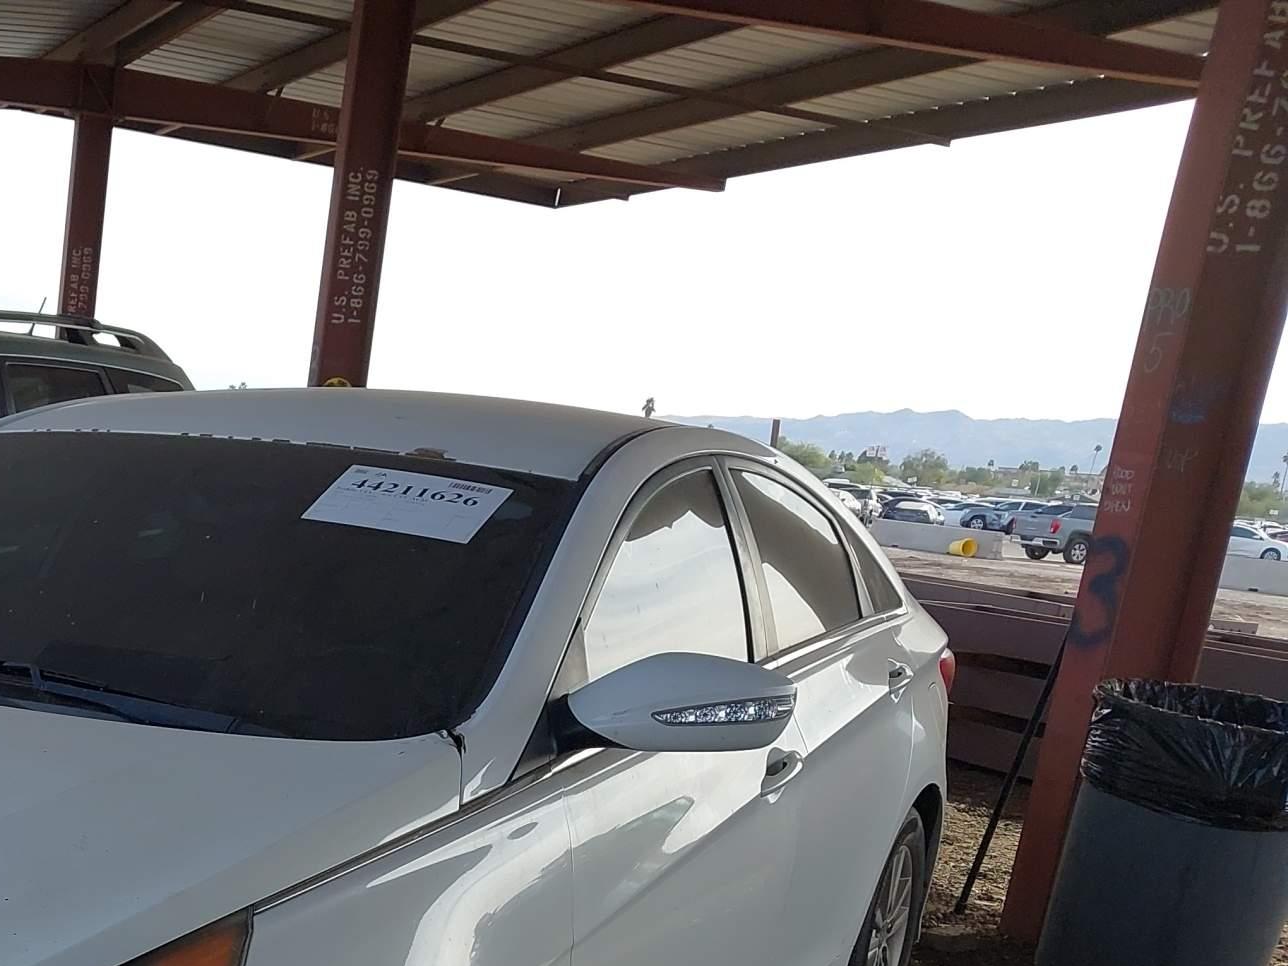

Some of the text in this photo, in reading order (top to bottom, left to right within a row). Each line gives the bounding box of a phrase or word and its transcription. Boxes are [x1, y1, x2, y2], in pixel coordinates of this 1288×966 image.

[331, 167, 364, 324] U.S. PREFAB INC.
[347, 169, 379, 324] 1-866-799-0969
[1206, 182, 1245, 254] U.S.
[67, 274, 80, 316] REFAB
[351, 479, 480, 508] 44211626
[1069, 534, 1130, 651] 3
